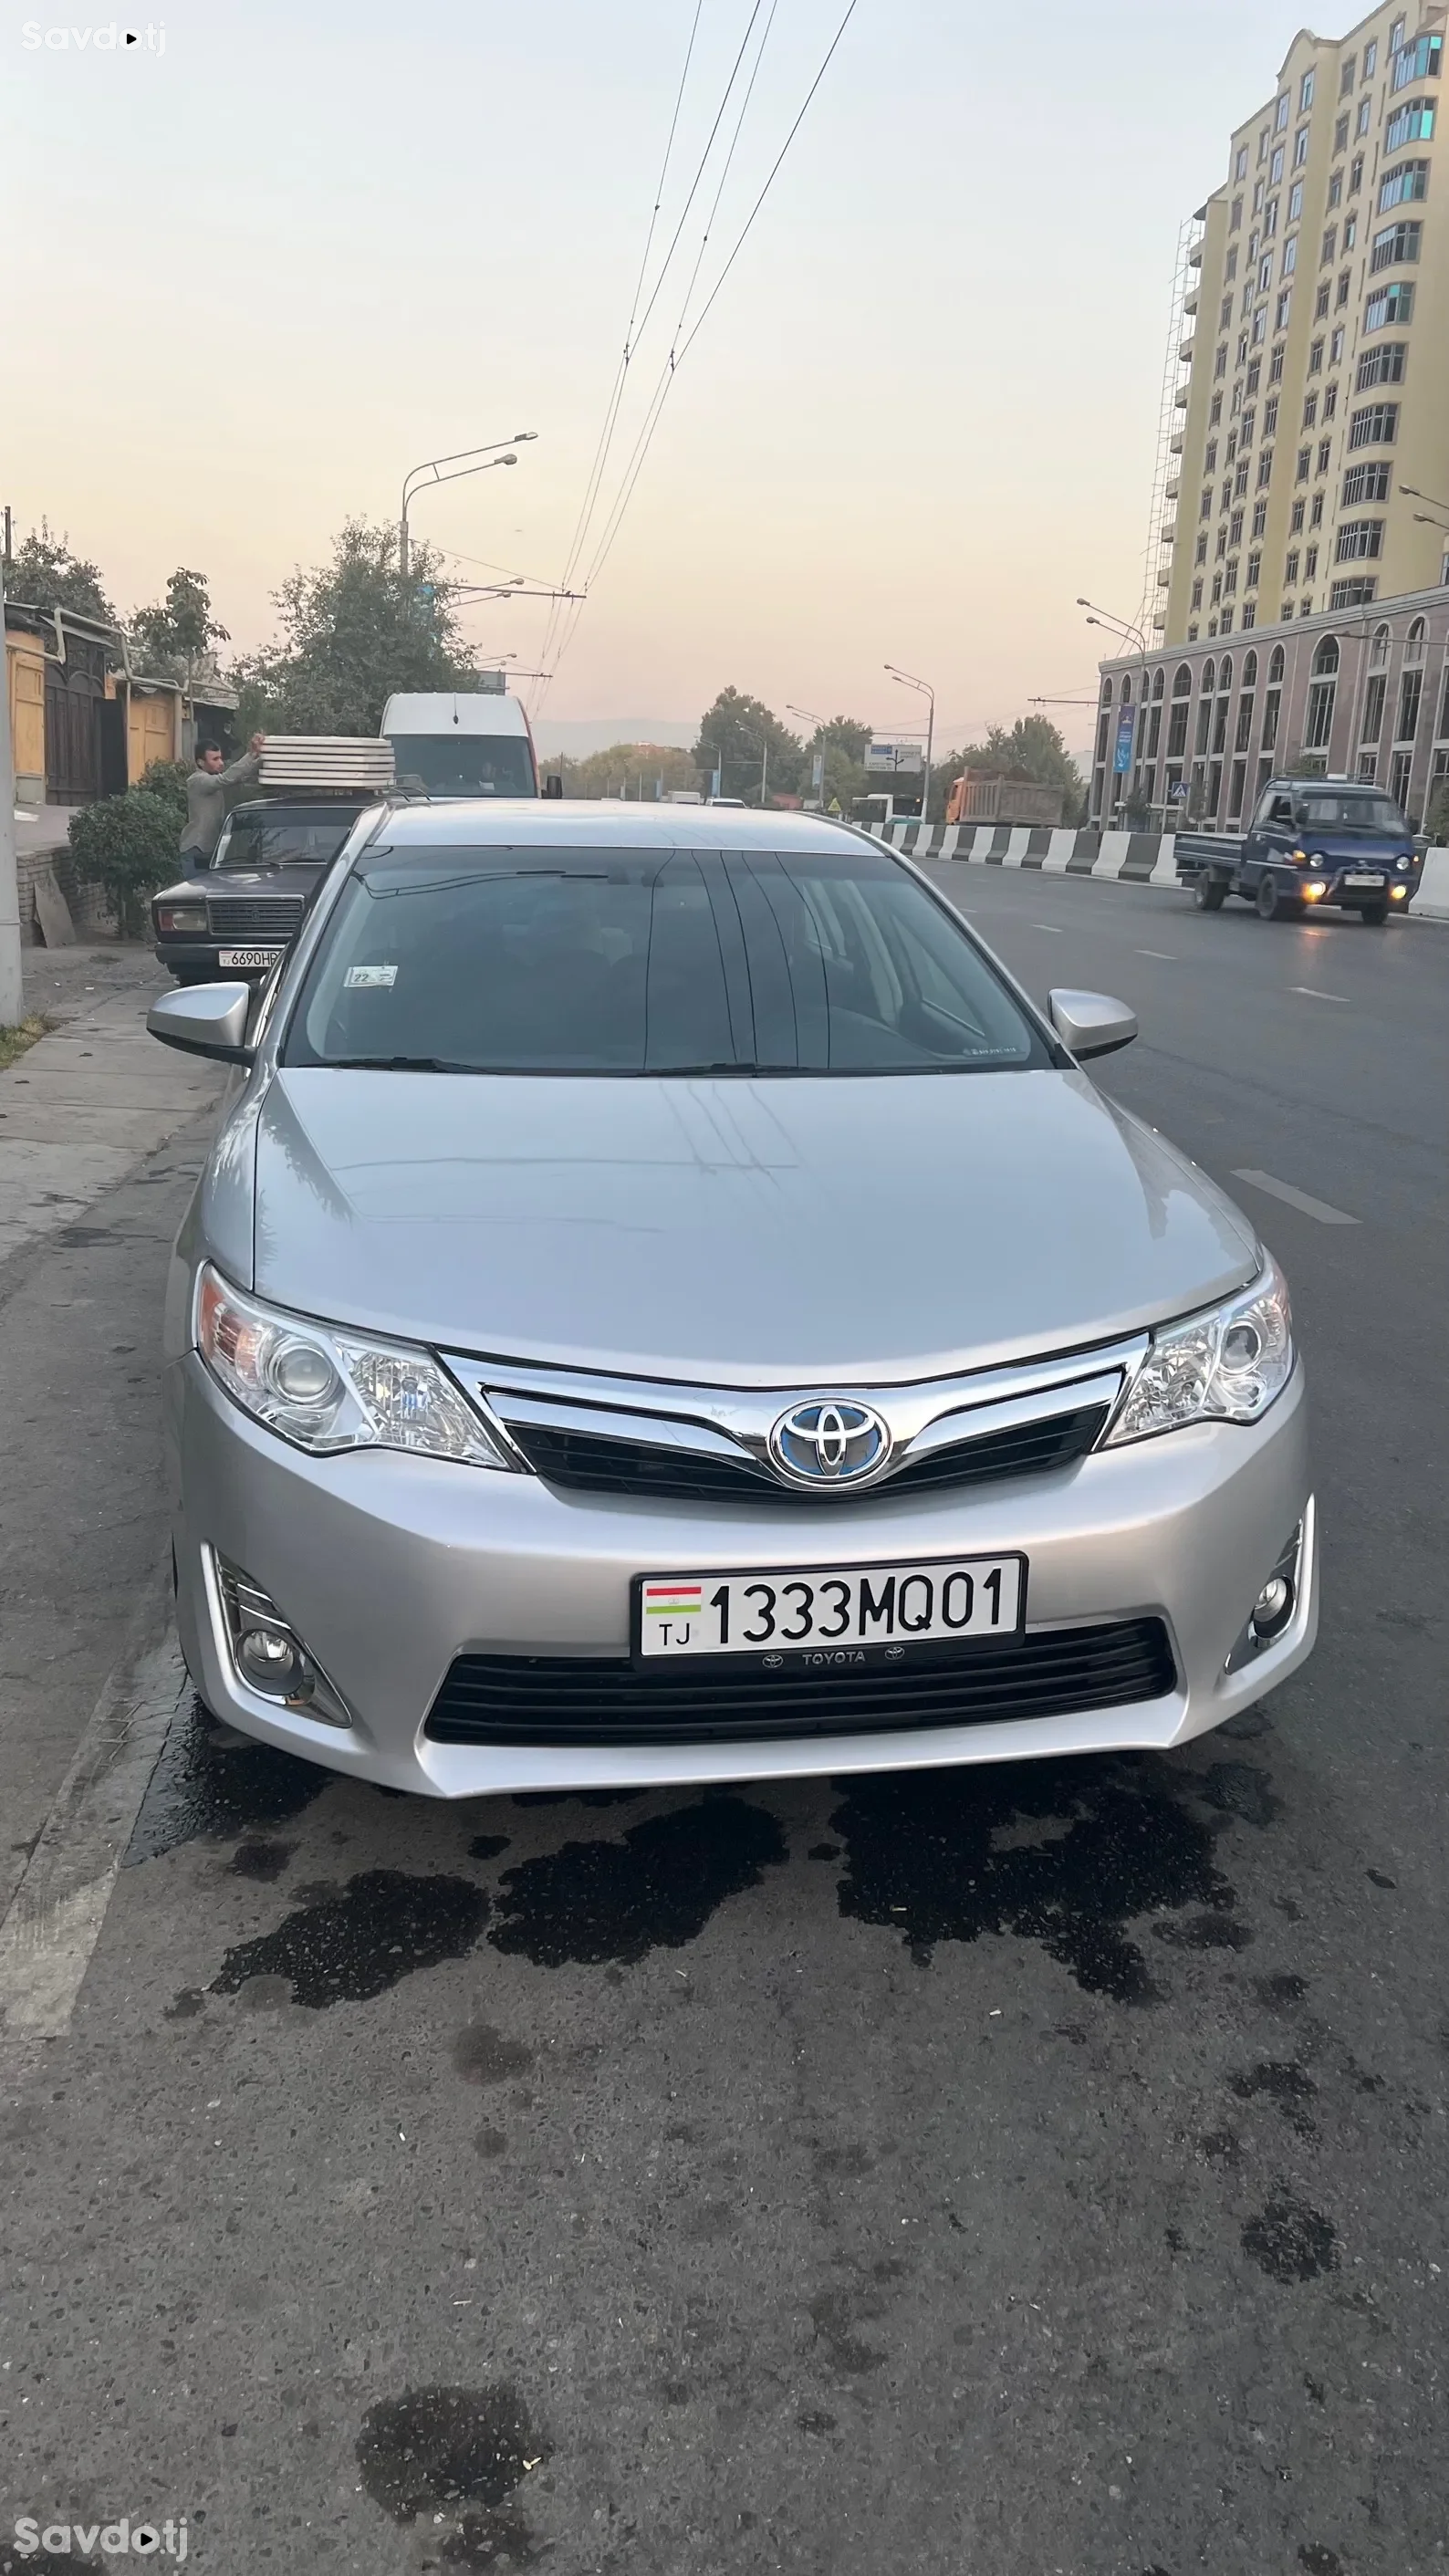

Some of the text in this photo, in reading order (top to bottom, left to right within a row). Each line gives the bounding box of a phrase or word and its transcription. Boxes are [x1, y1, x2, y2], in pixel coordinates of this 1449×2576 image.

[353, 973, 370, 983] 22
[659, 1567, 1003, 1646] TJ 1333MQ01
[802, 1650, 866, 1666] TOYOTA
